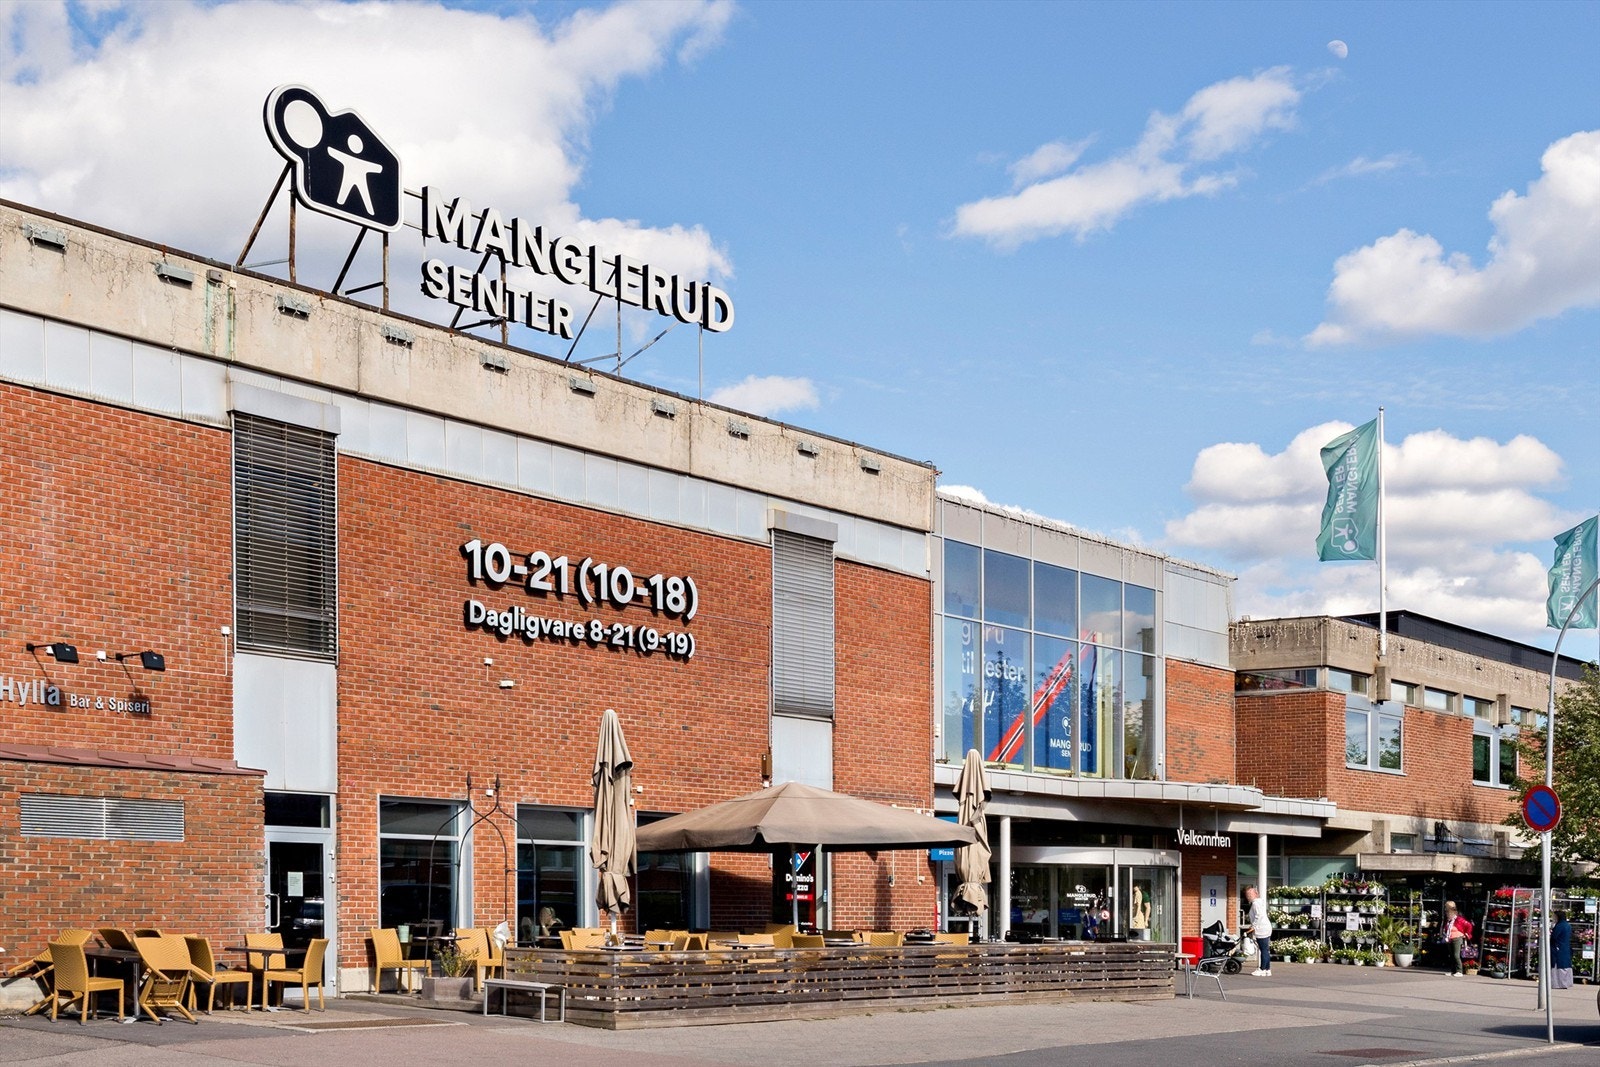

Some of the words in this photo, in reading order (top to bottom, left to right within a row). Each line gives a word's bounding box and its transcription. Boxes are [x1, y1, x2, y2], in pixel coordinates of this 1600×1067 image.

[422, 186, 735, 333] MANGLERUD
[421, 258, 574, 340] SENTER
[463, 539, 569, 594] 10-21
[579, 557, 699, 620] (10-18)
[468, 600, 585, 639] Dagligvare
[590, 619, 634, 647] 8-21
[639, 625, 696, 658] (9-19)
[0, 676, 60, 706] Hylla
[70, 694, 90, 708] Bar
[96, 697, 104, 709] &
[109, 698, 150, 713] Spiseri
[1050, 738, 1092, 752] MANGRUD
[1177, 829, 1231, 848] Velkommen
